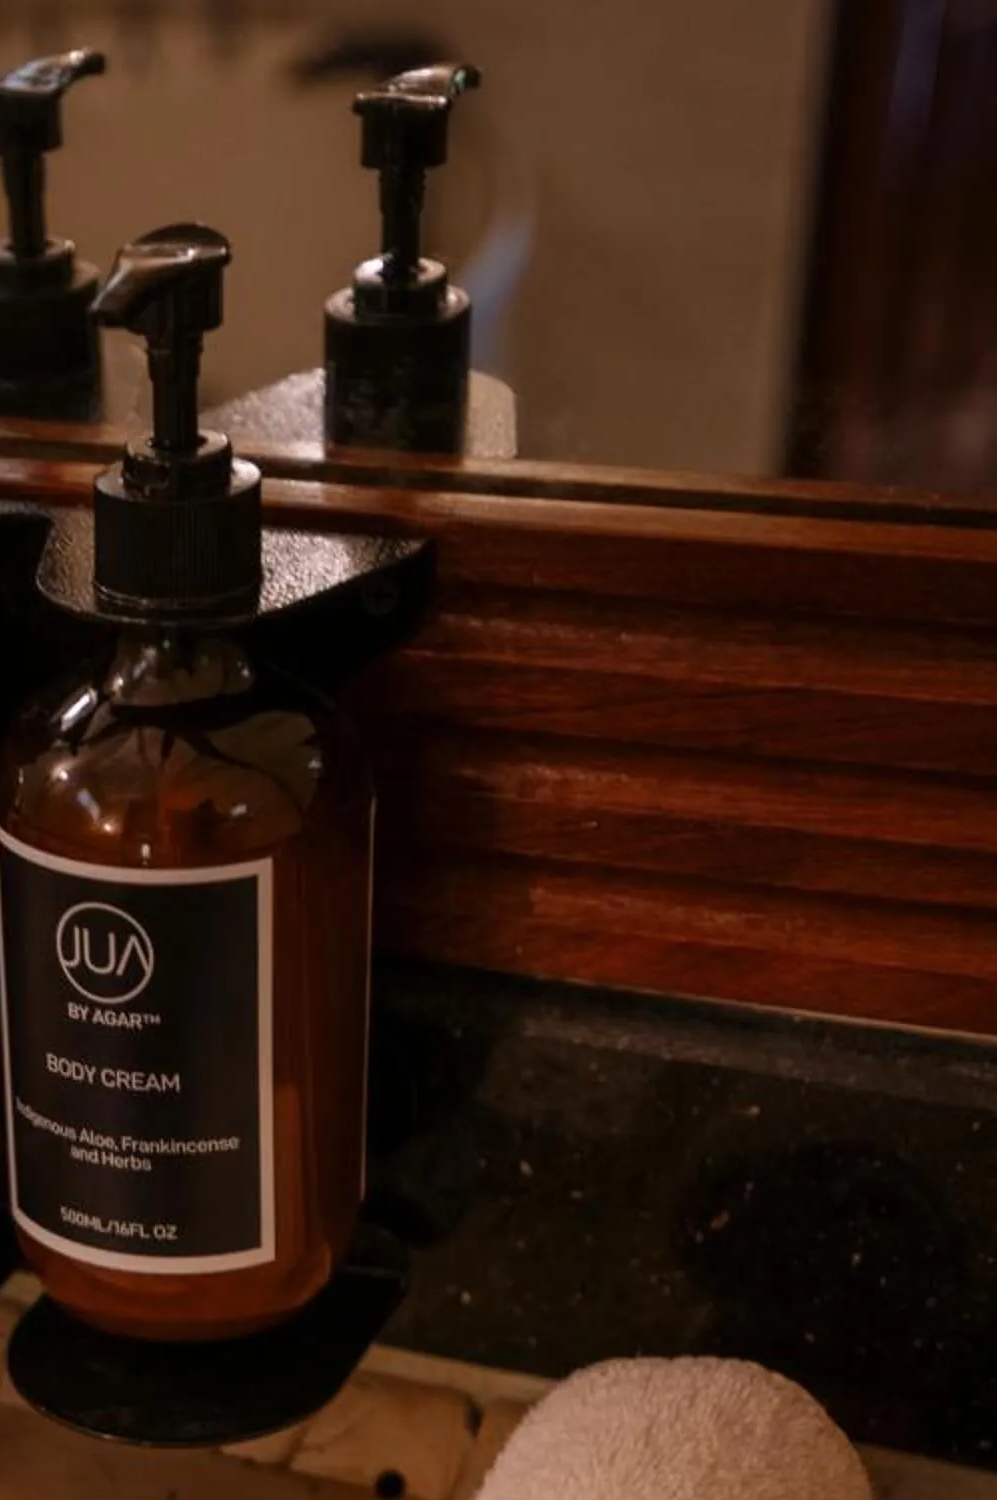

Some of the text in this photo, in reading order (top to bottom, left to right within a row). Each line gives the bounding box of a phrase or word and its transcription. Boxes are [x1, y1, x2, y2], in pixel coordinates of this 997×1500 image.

[63, 926, 150, 976] JUA
[68, 1002, 89, 1023] BY
[46, 1053, 181, 1093] BODY CREAM
[121, 1136, 240, 1155] Frankincense
[70, 1146, 152, 1172] and Herbs
[154, 1225, 178, 1240] OZ
